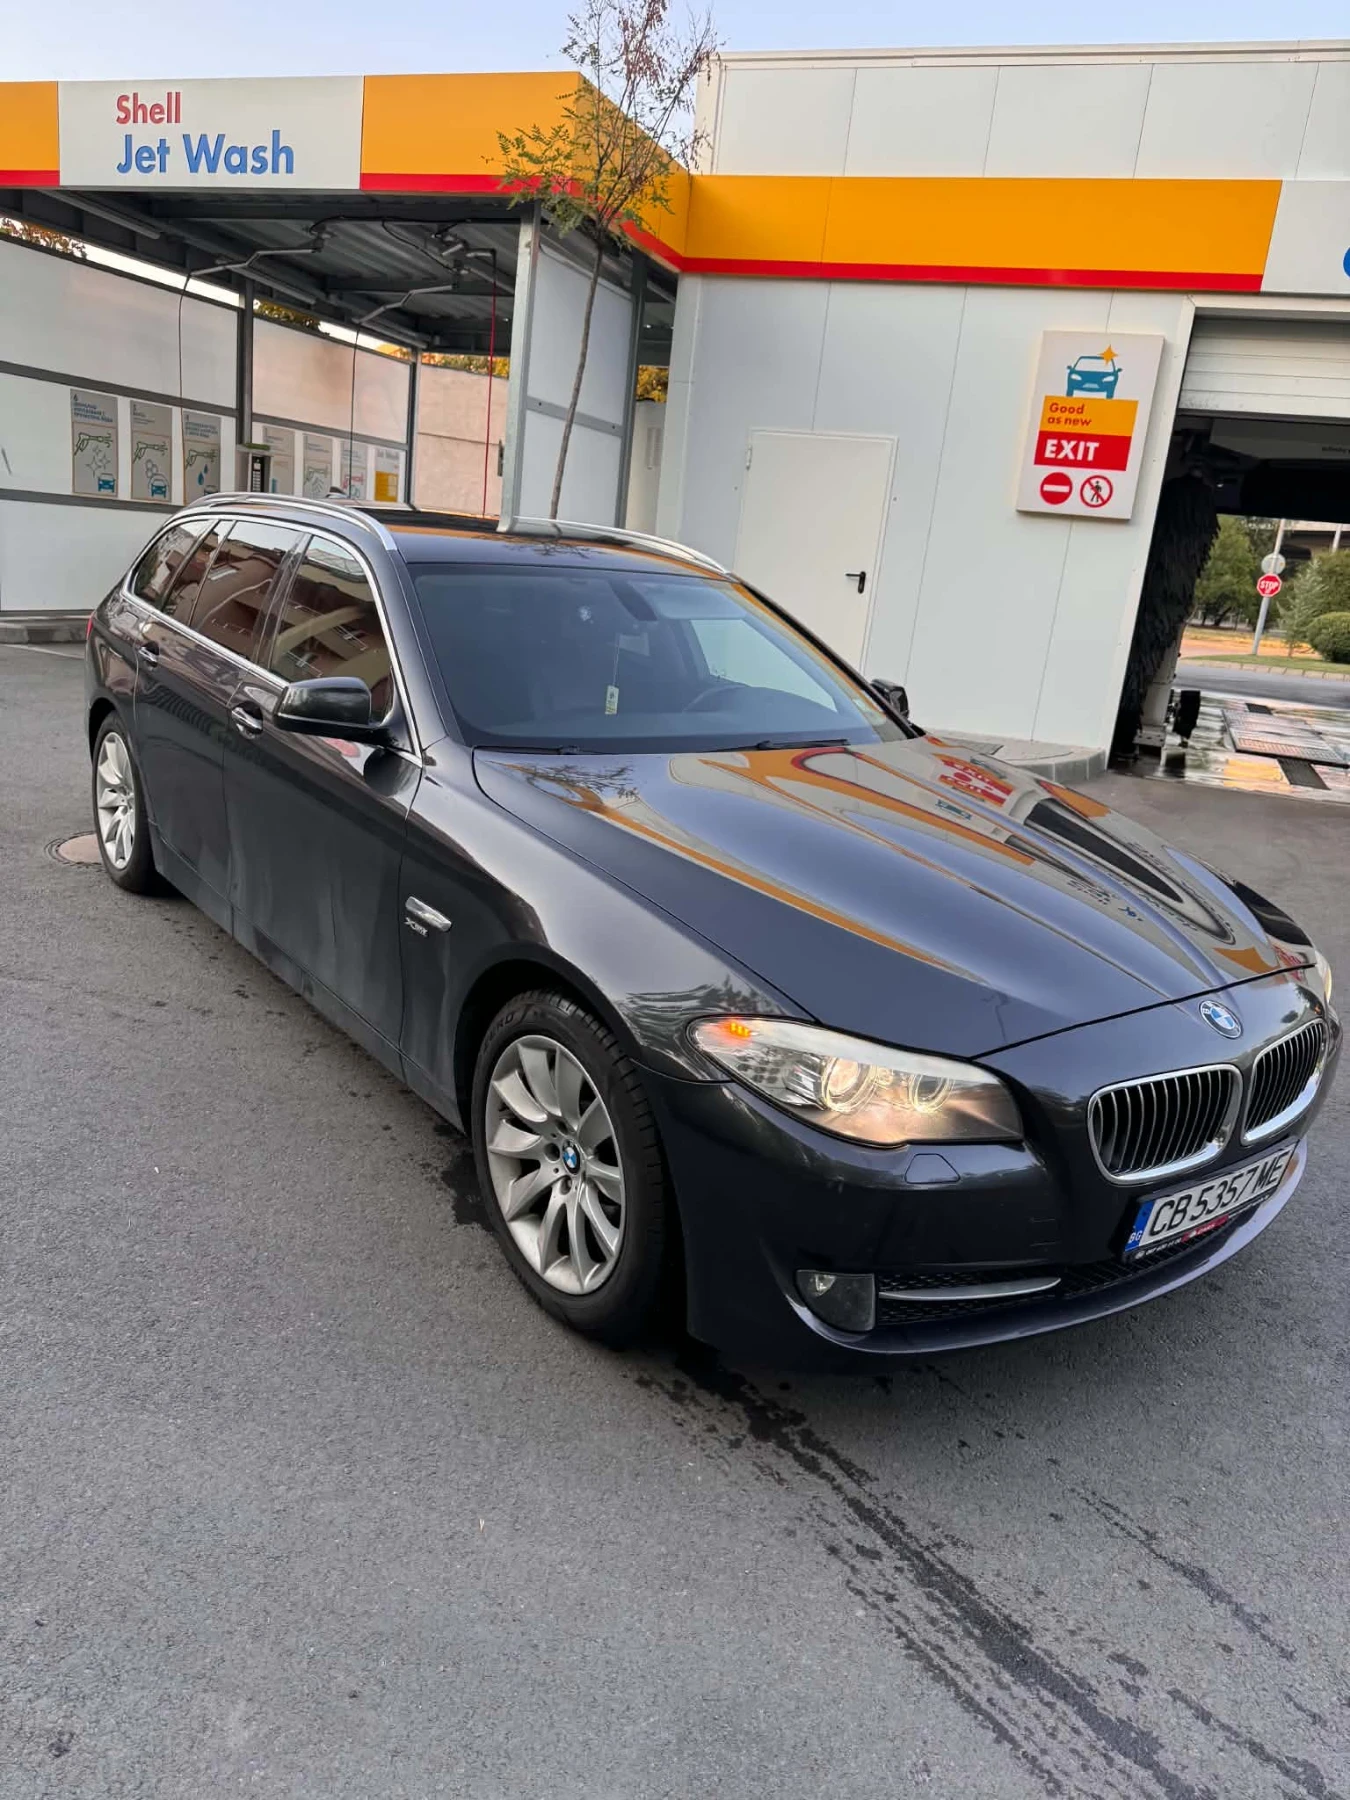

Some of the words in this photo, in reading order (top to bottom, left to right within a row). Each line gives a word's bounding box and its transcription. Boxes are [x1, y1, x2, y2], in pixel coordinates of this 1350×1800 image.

[116, 91, 181, 124] Shell
[116, 133, 171, 174] Jet
[182, 129, 294, 174] Wash
[1049, 402, 1085, 414] Good
[1047, 415, 1062, 425] as
[1063, 415, 1092, 427] new
[1044, 438, 1100, 461] EXIT
[1260, 580, 1279, 590] STOP
[1128, 1230, 1143, 1244] BG
